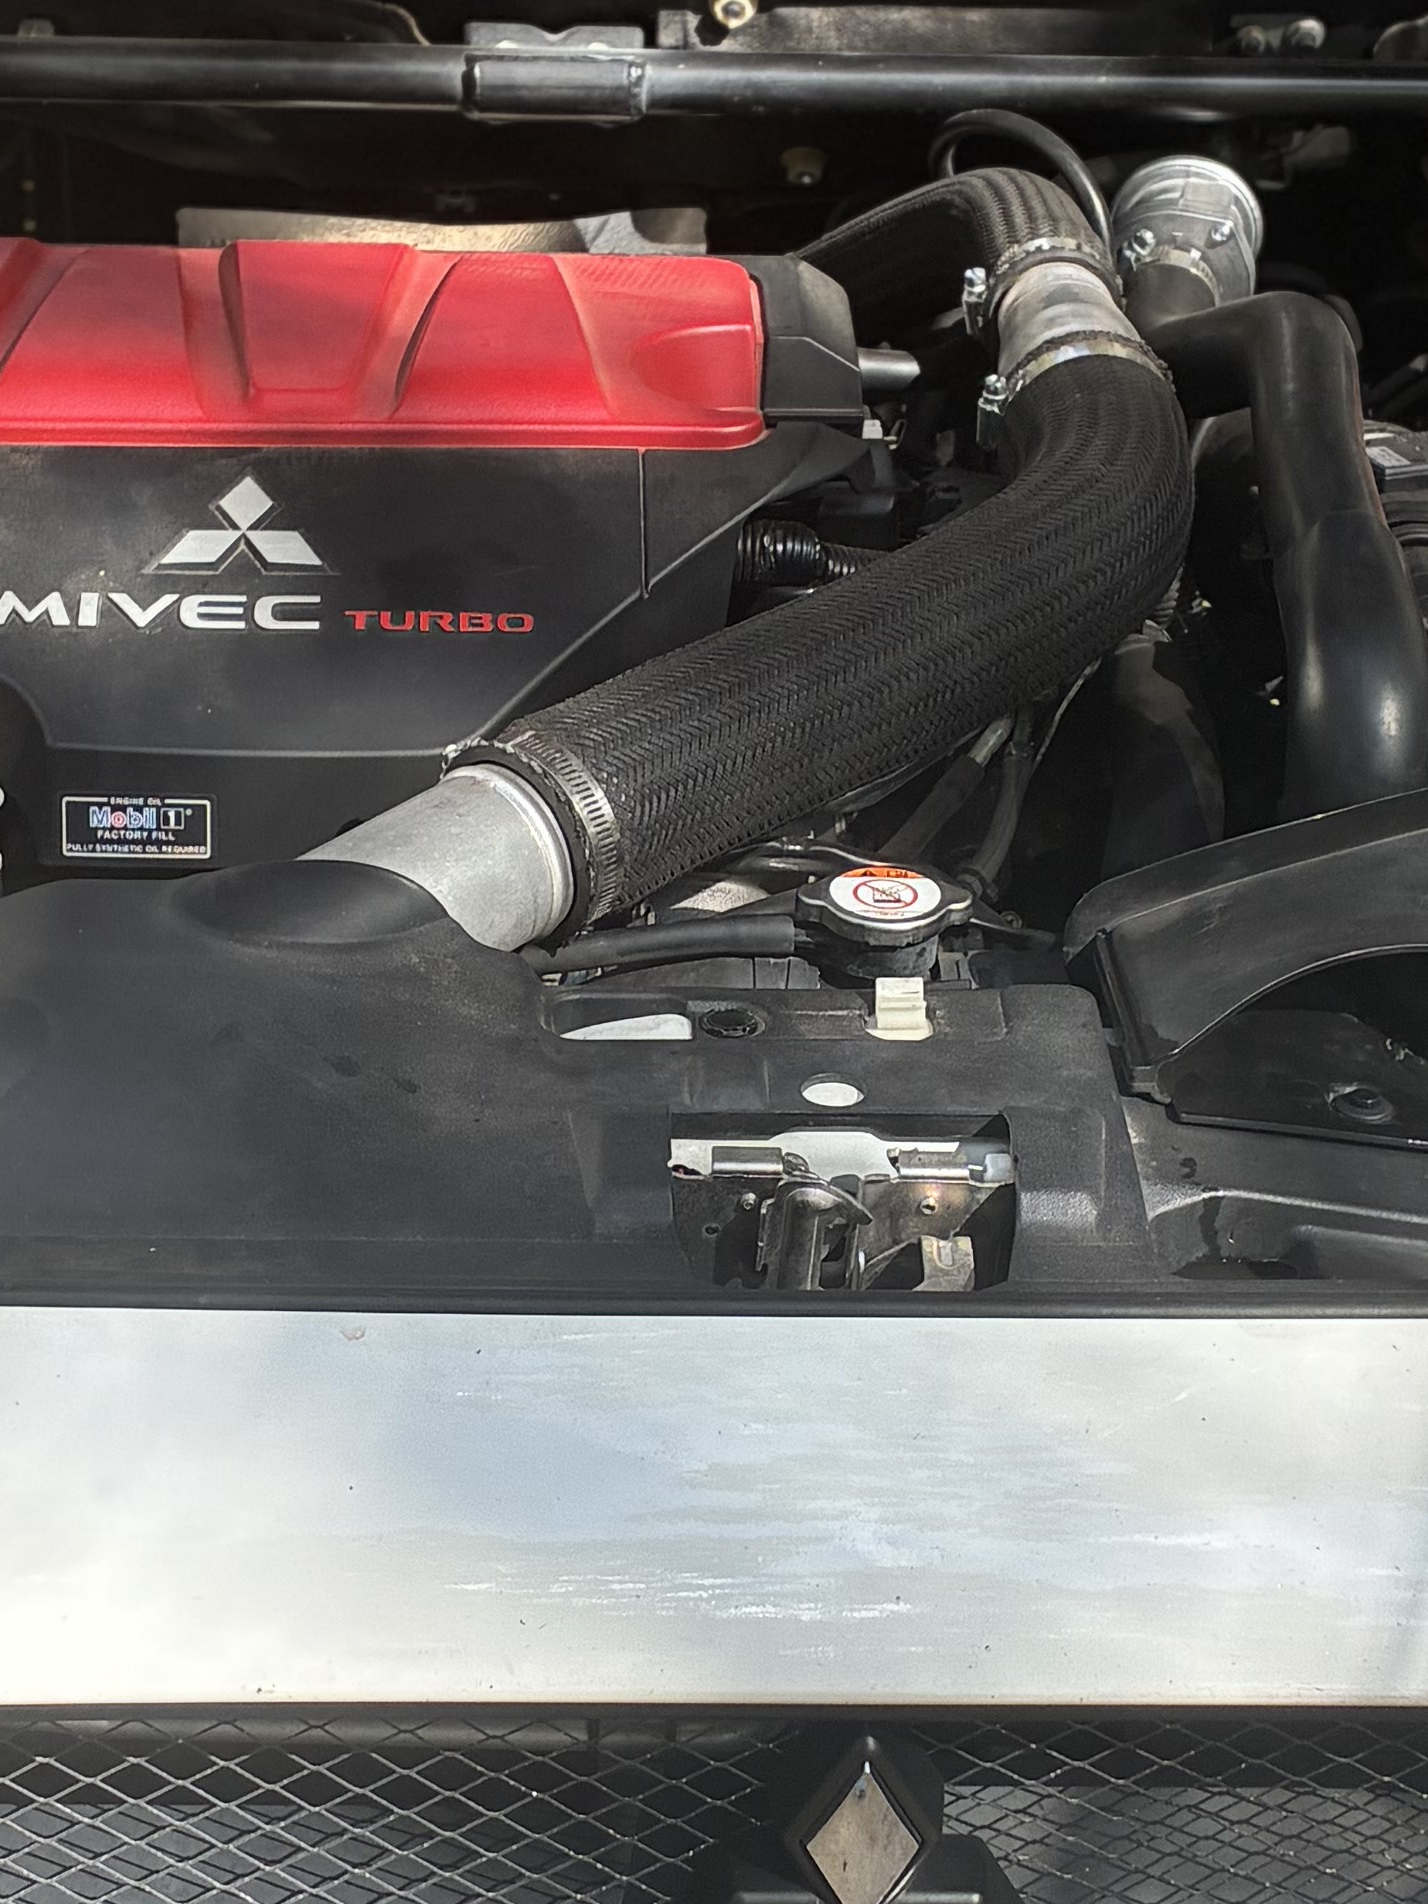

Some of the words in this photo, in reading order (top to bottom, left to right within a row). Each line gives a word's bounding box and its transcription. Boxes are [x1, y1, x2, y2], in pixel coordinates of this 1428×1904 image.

[344, 609, 534, 633] TURBO
[109, 797, 144, 805] ENGINE
[89, 806, 157, 829] Mobil
[97, 830, 148, 840] FACTORY
[151, 831, 175, 841] FILL
[66, 843, 93, 851] FULLY
[96, 844, 142, 853] SYNTHETIC
[145, 845, 159, 853] OIL
[161, 845, 206, 854] REQUIRED
